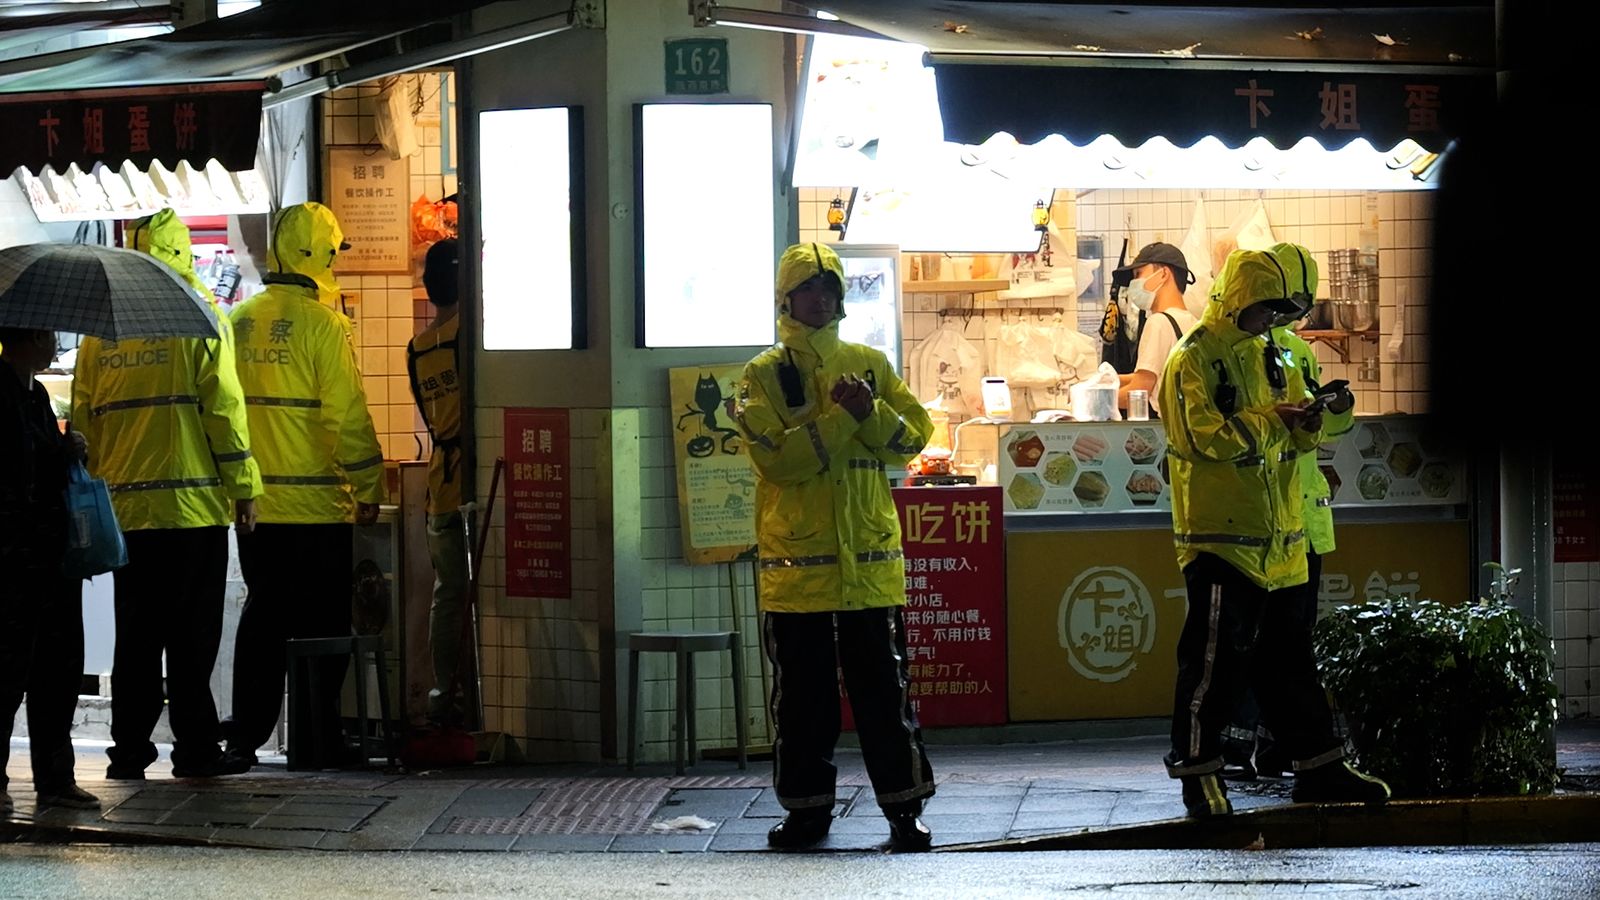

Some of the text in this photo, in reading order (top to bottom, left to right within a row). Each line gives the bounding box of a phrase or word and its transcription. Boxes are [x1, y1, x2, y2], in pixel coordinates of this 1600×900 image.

[674, 47, 721, 75] 162
[38, 101, 200, 157] 卞姐蛋饼
[353, 164, 385, 180] 招聘
[345, 187, 395, 199] 餐饮操作工
[98, 348, 169, 371] POLICE
[521, 428, 553, 454] 招聘
[513, 462, 563, 481] 餐饮操作工
[905, 500, 992, 544] 吃饼
